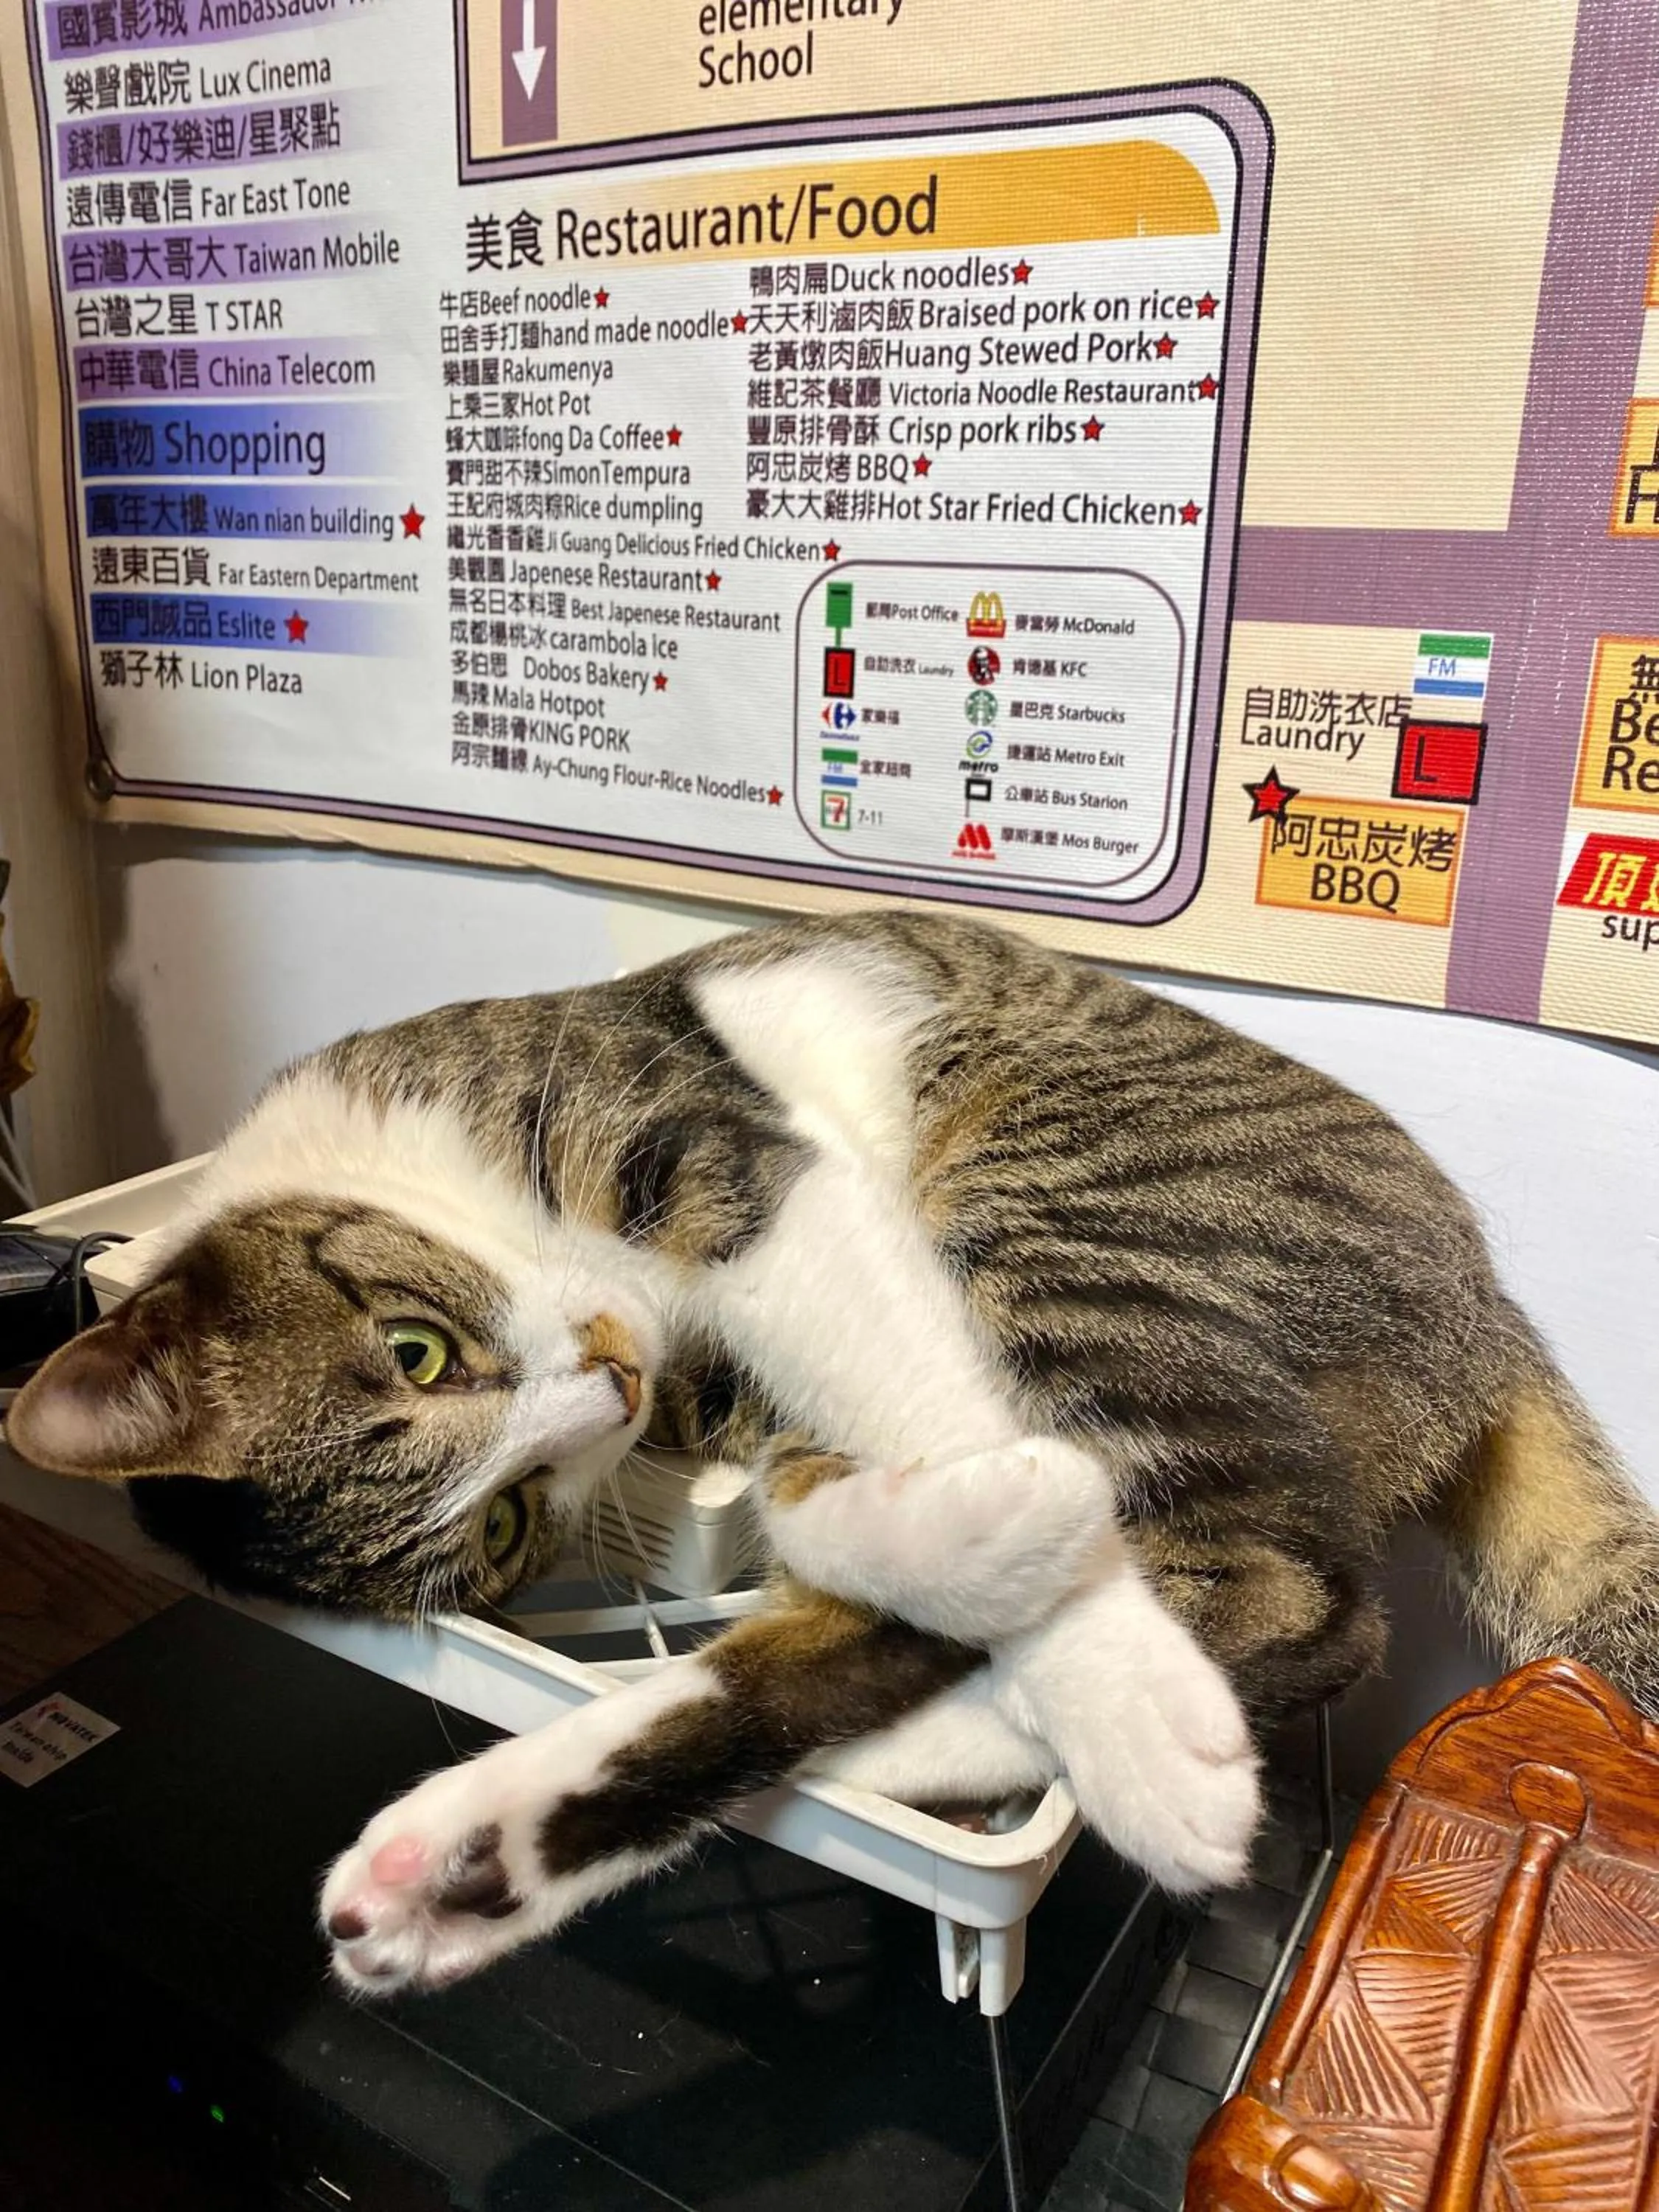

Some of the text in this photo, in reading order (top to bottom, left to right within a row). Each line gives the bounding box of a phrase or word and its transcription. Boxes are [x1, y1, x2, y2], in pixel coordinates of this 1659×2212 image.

[698, 29, 813, 88] School
[64, 55, 331, 114] 樂聲戲院 Lux Cinema
[66, 178, 350, 228] 遠傳電信 Far East Tone
[466, 175, 938, 272] 美食 Restaurant/Food
[69, 231, 400, 285] 台灣大哥大 Taiwan Mobile
[903, 256, 1009, 289] noodles
[526, 283, 591, 312] noodle
[919, 294, 1015, 329] Braised
[1023, 291, 1085, 333] pork
[1093, 296, 1130, 321] on
[1140, 288, 1194, 319] rice
[74, 293, 283, 339] 台灣之星 T STAR
[596, 316, 651, 343] made
[658, 310, 728, 340] noodle
[979, 332, 1079, 366] Stewed
[1087, 330, 1153, 363] Pork
[79, 348, 375, 393] 中華電信 China Telecom
[503, 357, 613, 386] Rakumenya
[559, 391, 591, 416] Pot
[889, 380, 971, 407] Victoria
[978, 378, 1057, 406] Noodle
[1064, 378, 1197, 403] Restaurant
[85, 420, 326, 476] 購物 Shopping
[568, 425, 593, 448] Da
[599, 423, 664, 451] Coffee
[889, 416, 952, 451] Crisp
[959, 414, 1019, 451] pork
[1026, 413, 1077, 444] ribs
[746, 450, 908, 484] 阿忠炭烤 BBQ
[90, 494, 394, 541] 萬年大樓 Wan nian building
[606, 494, 703, 526] dumpling
[928, 492, 979, 521] Star
[987, 492, 1054, 524] Fried
[1062, 492, 1176, 526] Chicken
[561, 531, 611, 558] Guang
[616, 532, 689, 556] Delicious
[695, 535, 738, 557] Fried
[744, 536, 820, 560] Chicken
[92, 546, 420, 596] 遠東百貨 Far Eastern Department
[509, 558, 592, 589] Japenese
[599, 562, 702, 591] Restaurant
[94, 601, 276, 640] 西門誠品 Eslite
[571, 599, 604, 620] Best
[608, 600, 680, 626] Japenese
[685, 605, 781, 632] Restaurant
[922, 605, 959, 622] Office
[1062, 618, 1135, 635] McDonald
[550, 629, 647, 658] carambola
[652, 636, 678, 659] ice
[100, 650, 302, 694] 獅子林 Lion Plaza
[524, 655, 581, 684] Dobos
[586, 661, 650, 695] Bakery
[919, 664, 954, 678] Laundry
[1060, 661, 1088, 678] KFC
[1428, 658, 1456, 677] FM
[493, 684, 535, 710] Mala
[540, 689, 605, 721] Hotpot
[1058, 703, 1126, 723] Starbucks
[580, 726, 631, 754] PORK
[1242, 714, 1366, 761] Laundry
[1054, 748, 1096, 765] Metro
[1099, 751, 1125, 768] Exit
[1413, 735, 1438, 782] L
[532, 754, 609, 788] Ay-Chung
[696, 778, 765, 804] Noodles
[1052, 790, 1076, 807] Bus
[858, 809, 883, 825] 7-11
[1062, 834, 1089, 849] Mos
[1093, 837, 1139, 856] Burger
[1272, 813, 1457, 874] 阿忠炭烤
[1310, 864, 1400, 914] BBQ
